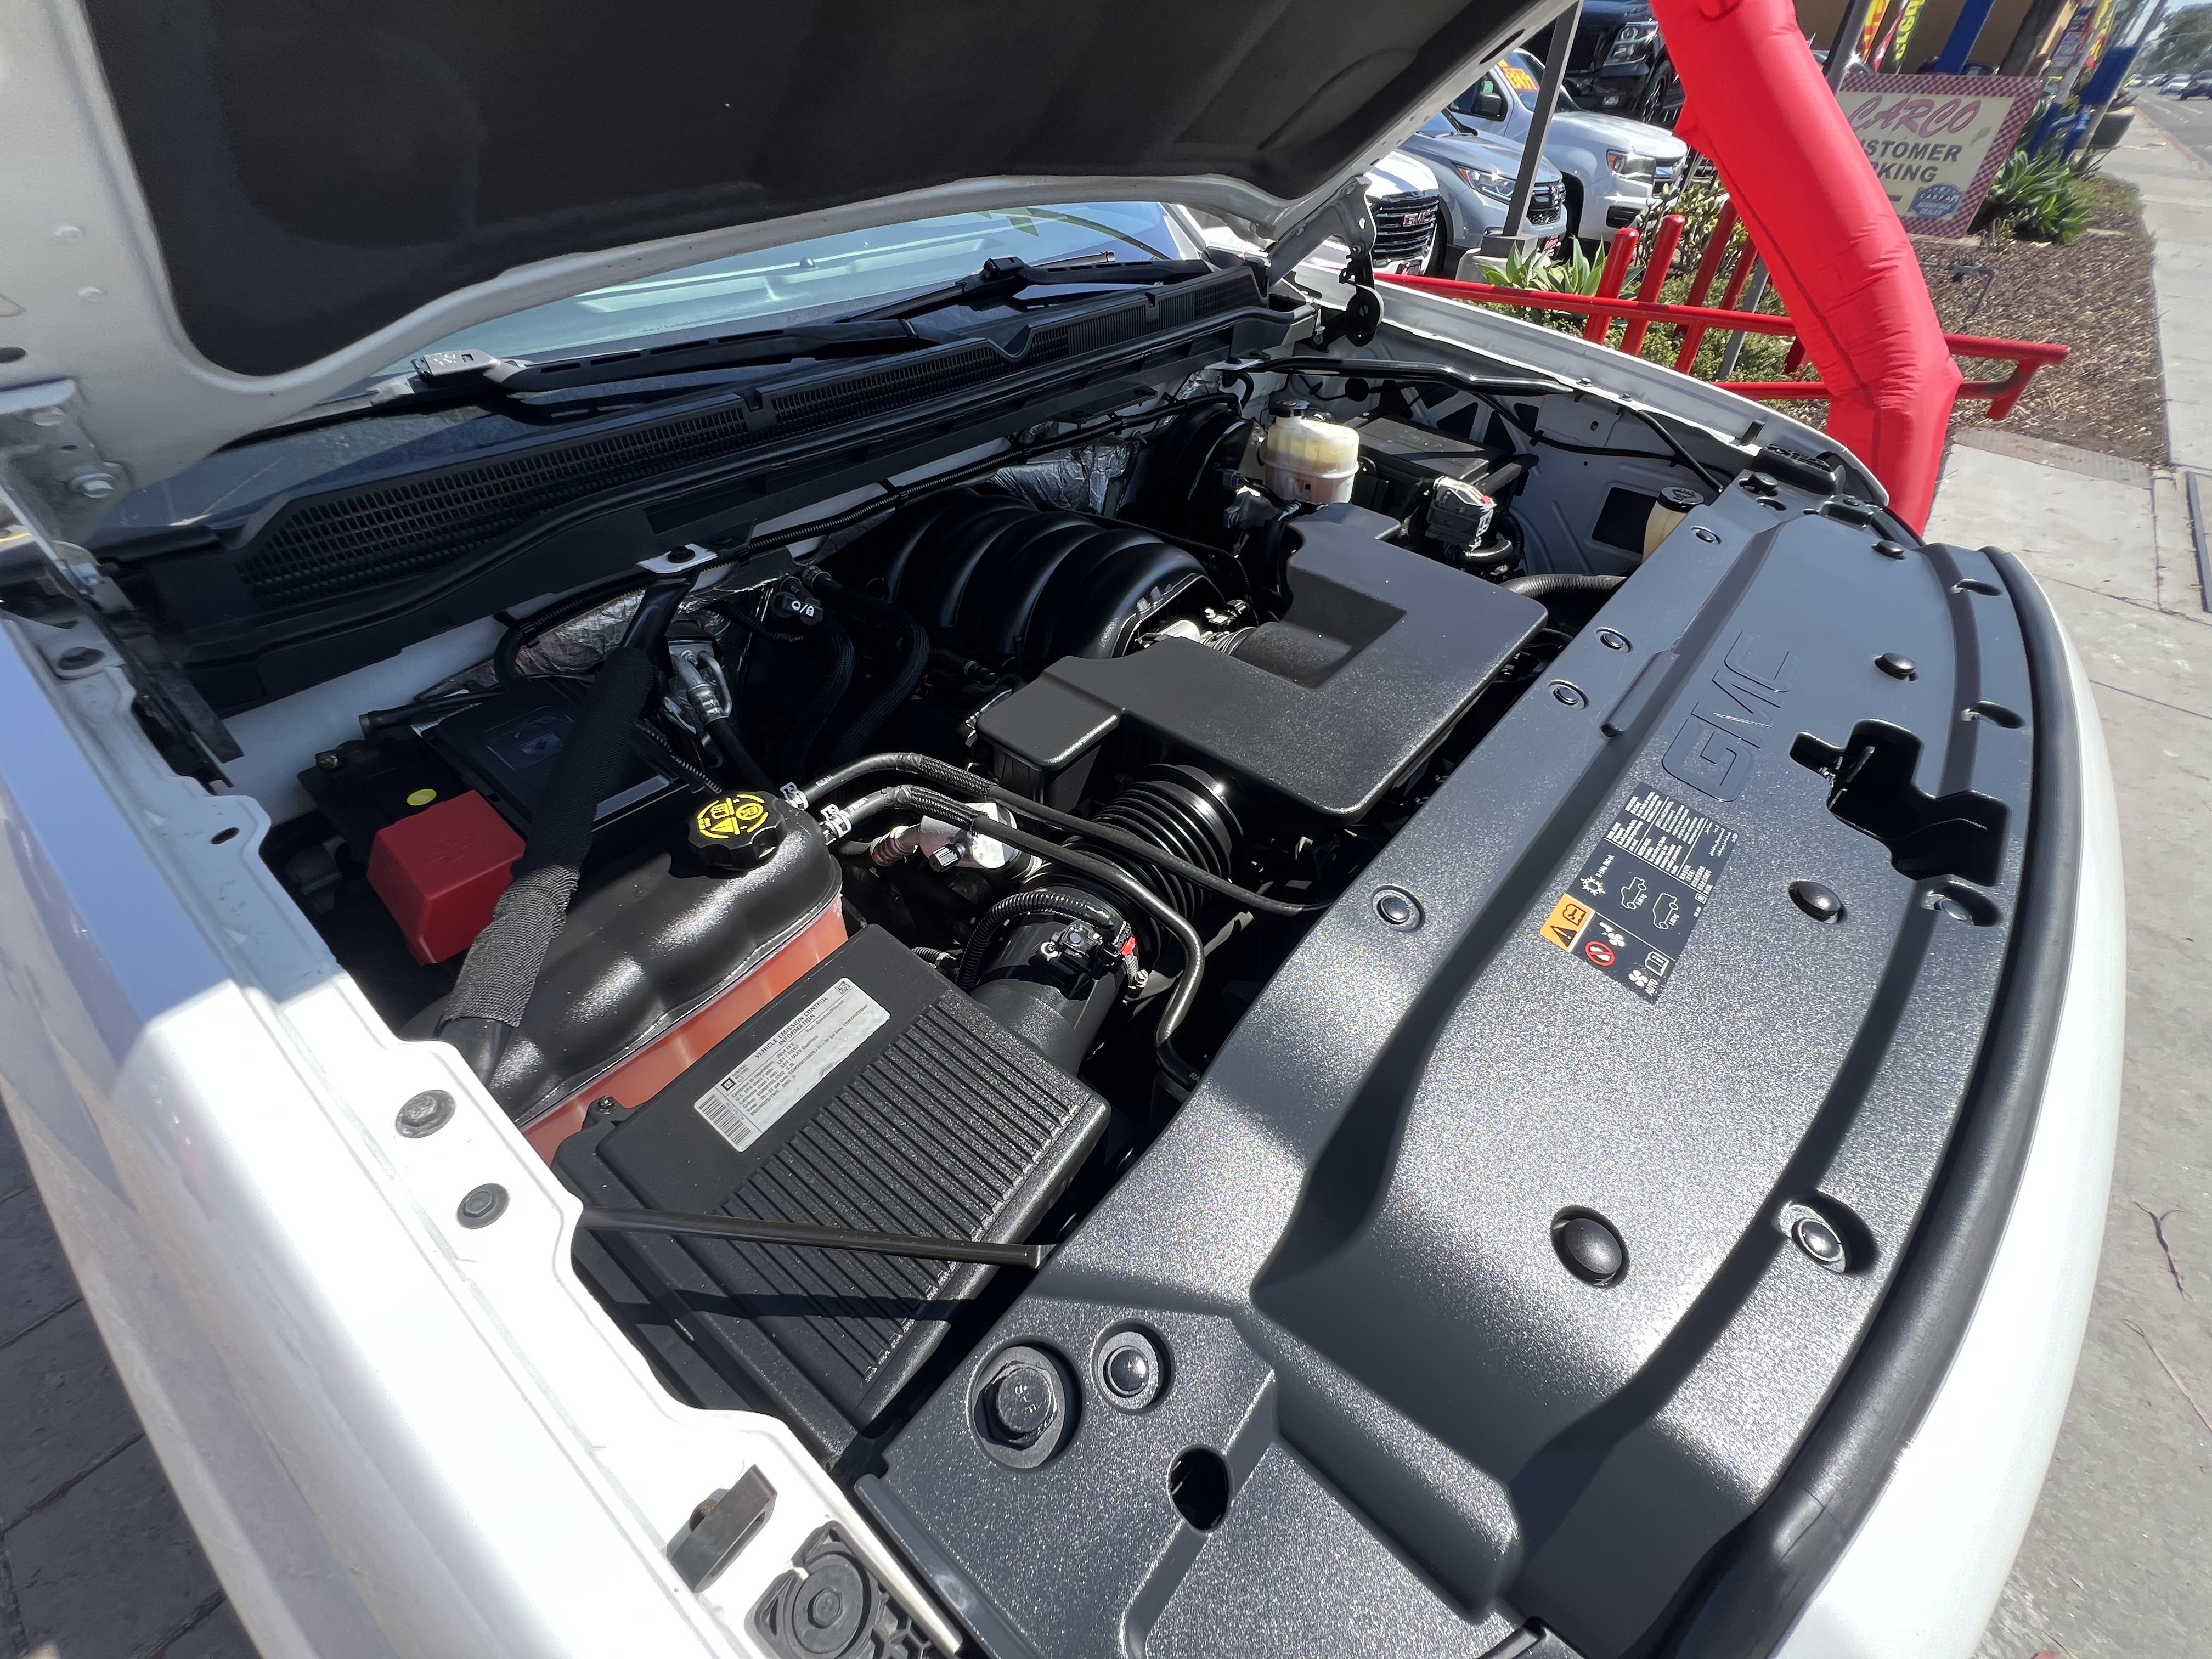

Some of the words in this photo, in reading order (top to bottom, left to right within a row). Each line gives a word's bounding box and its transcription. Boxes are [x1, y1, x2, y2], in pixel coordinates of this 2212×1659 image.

[1848, 95, 1982, 138] CARCO
[1860, 138, 1962, 162] STOMER
[1870, 161, 1938, 183] KING
[1403, 209, 1432, 227] GMC
[1662, 631, 1802, 802] GMC
[1643, 976, 1660, 997] AUTO
[754, 1037, 778, 1059] VEHICLE
[777, 1015, 804, 1039] EMISSION
[803, 995, 829, 1018] CONTROL
[777, 1013, 816, 1046] INFORMATION
[776, 1048, 787, 1058] 2014
[776, 1056, 786, 1065] LDT
[780, 1059, 790, 1068] LDT
[790, 1048, 803, 1059] ULEV
[731, 1081, 750, 1098] Conforms
